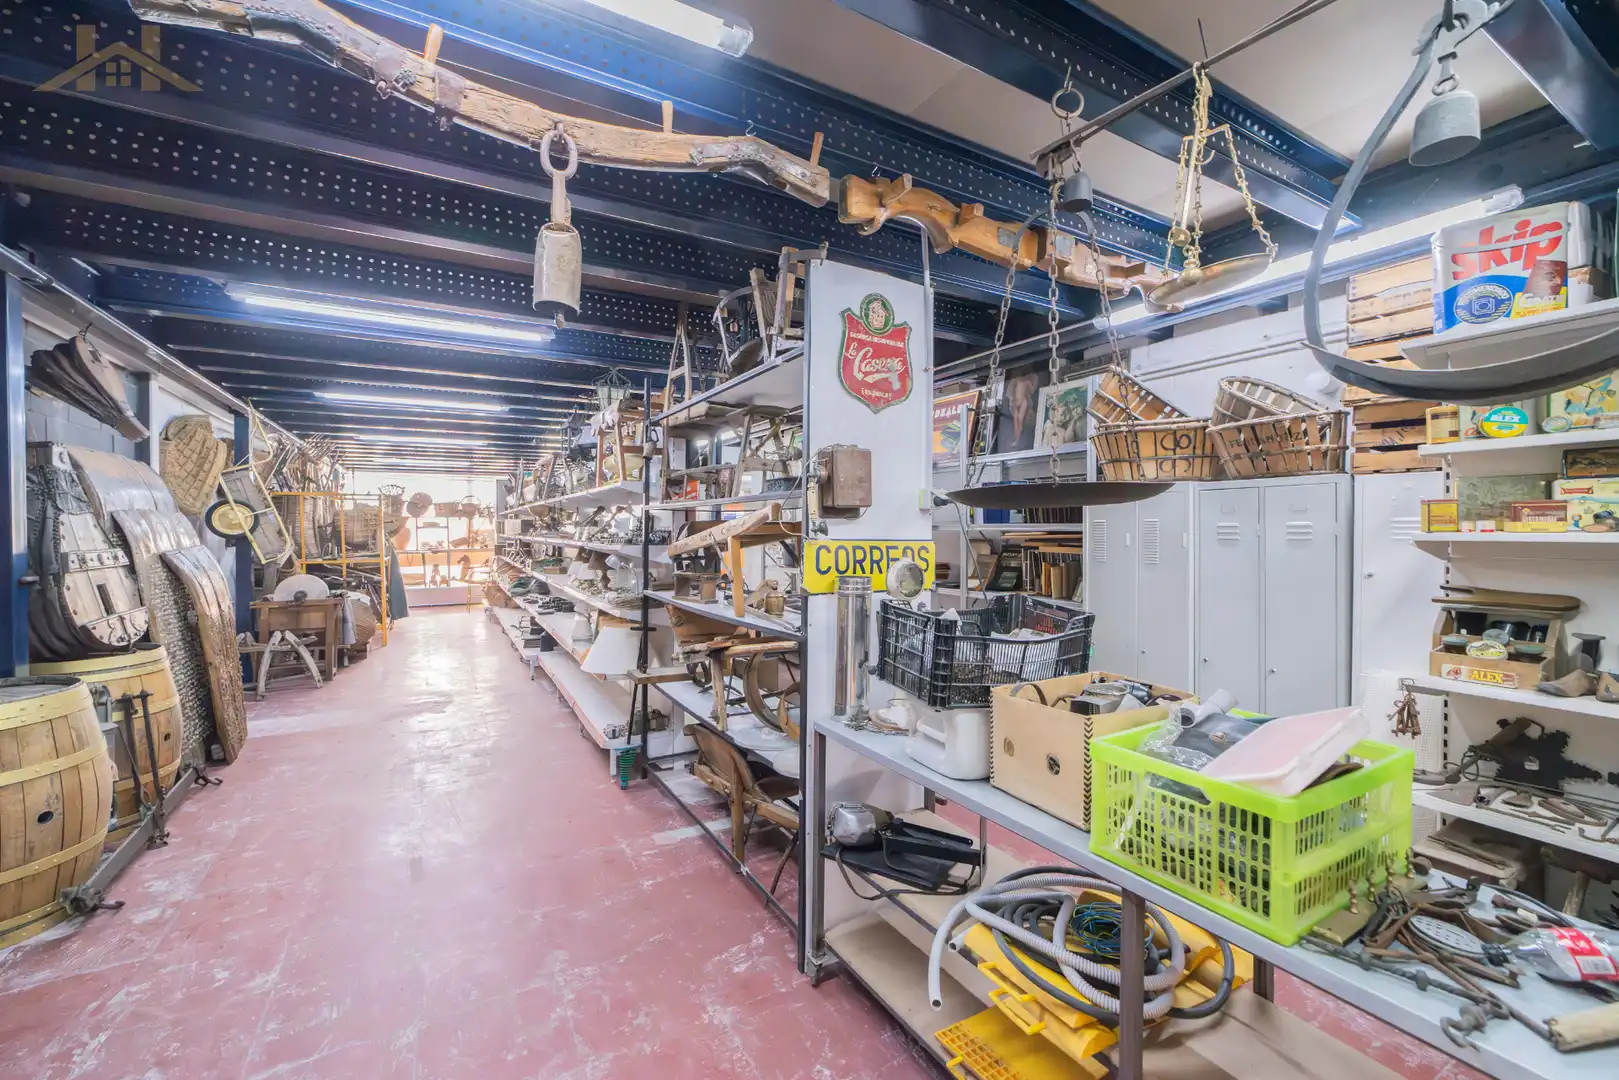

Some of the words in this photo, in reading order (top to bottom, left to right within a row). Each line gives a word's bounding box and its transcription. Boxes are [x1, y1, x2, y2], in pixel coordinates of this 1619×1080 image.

[1451, 219, 1563, 281] skip
[844, 341, 858, 359] La
[1471, 669, 1504, 684] ALEX
